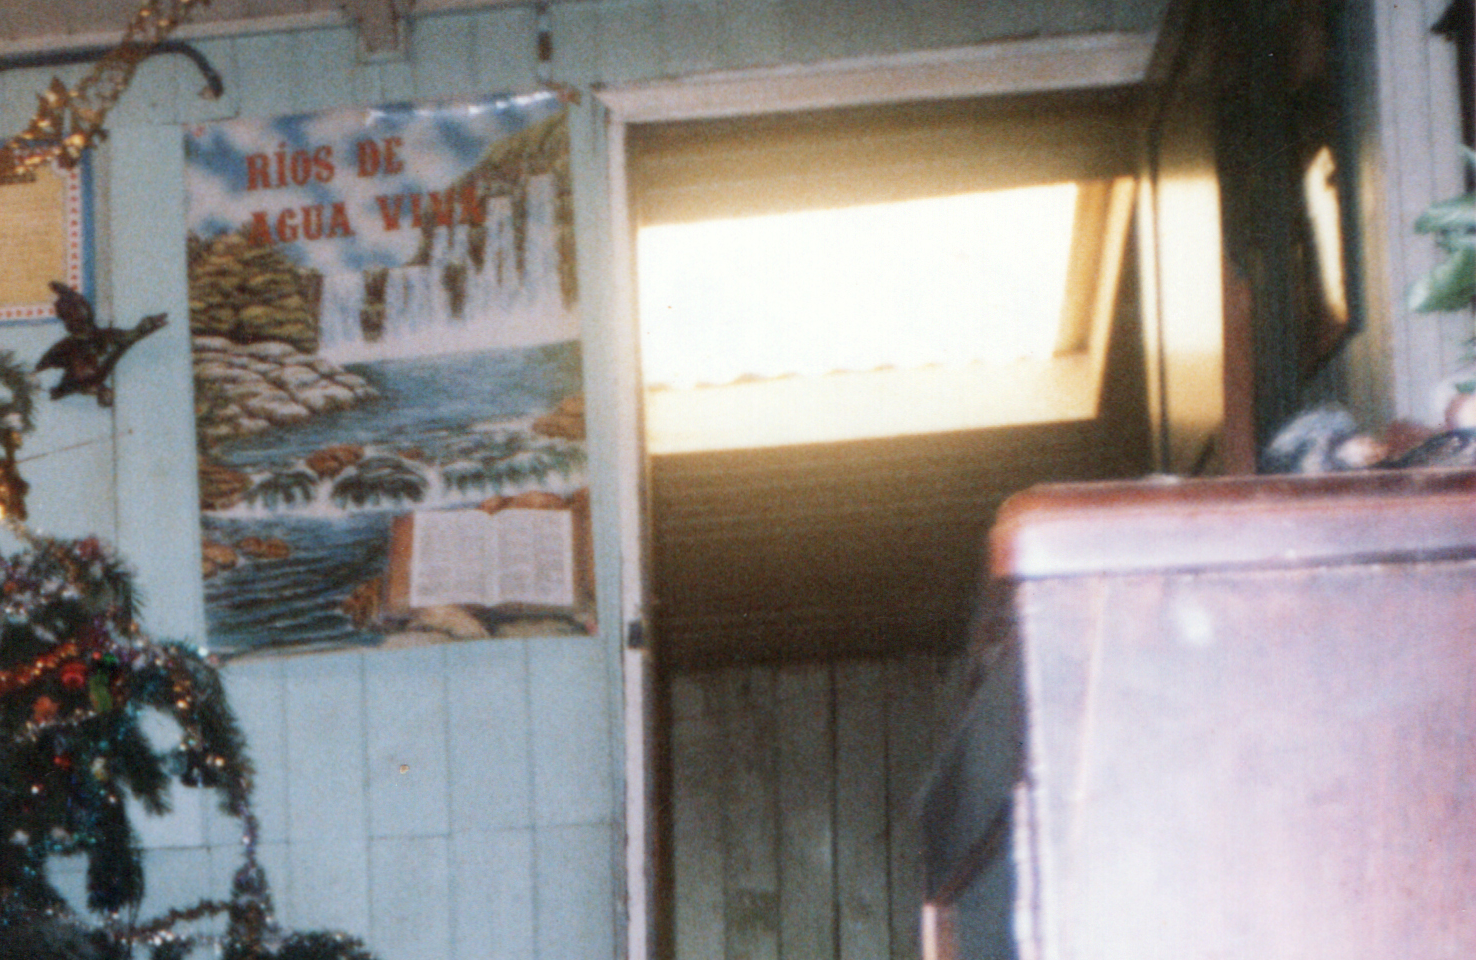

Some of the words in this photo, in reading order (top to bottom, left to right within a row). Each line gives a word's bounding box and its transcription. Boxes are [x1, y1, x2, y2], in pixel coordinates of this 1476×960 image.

[246, 142, 336, 191] RÍOS
[356, 136, 406, 179] DE
[248, 200, 356, 246] AGUA
[375, 185, 487, 232] VIVA
